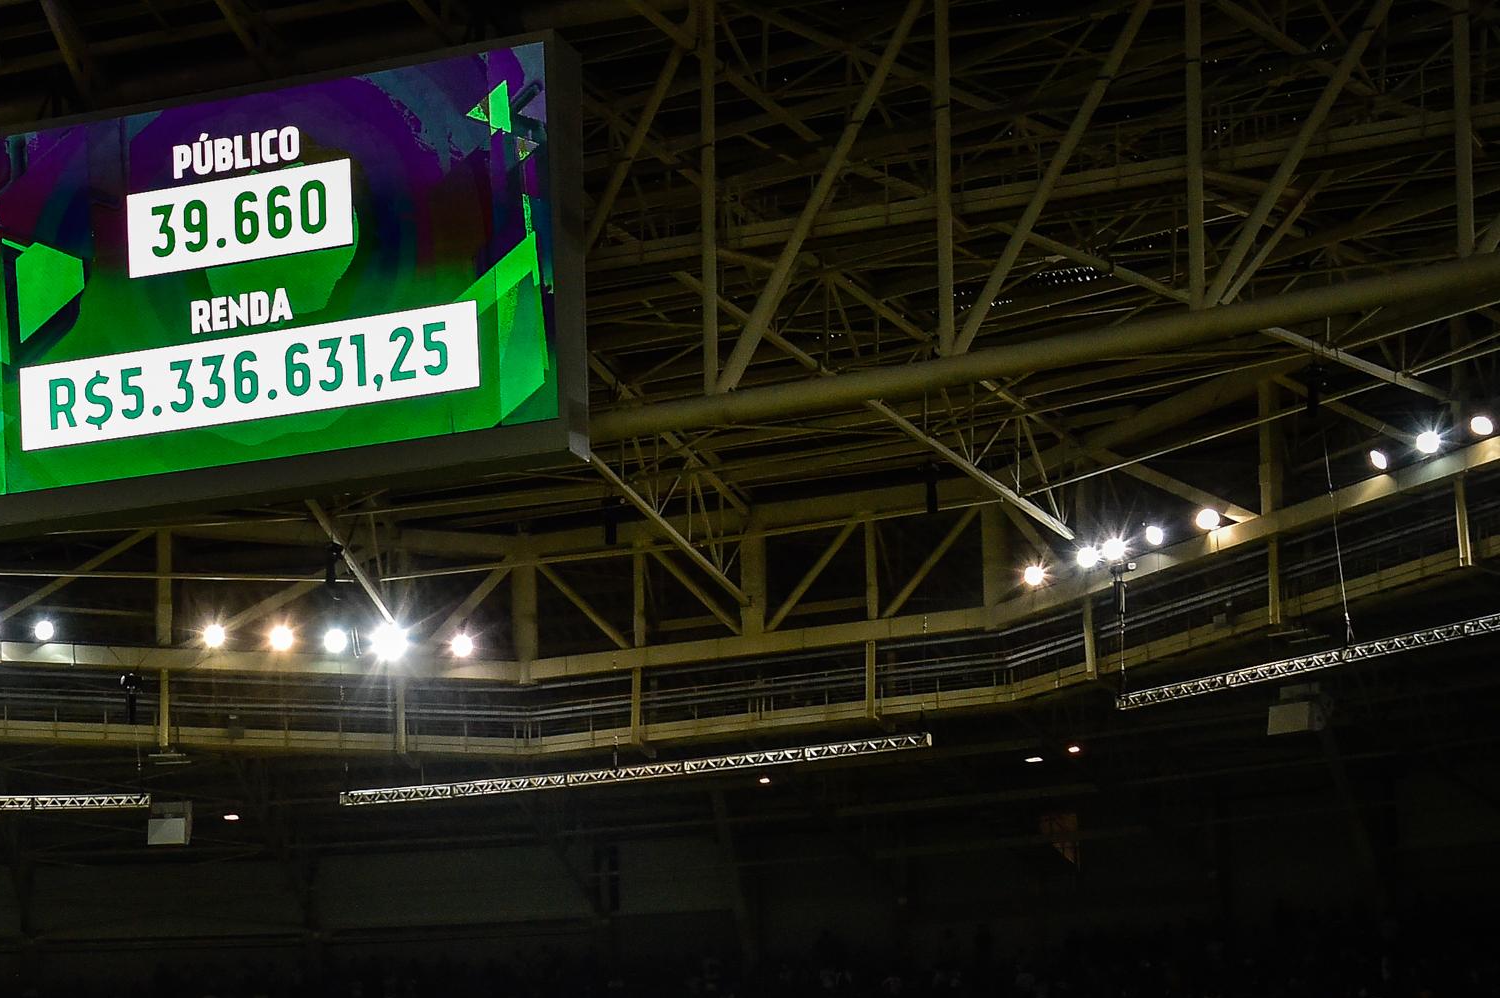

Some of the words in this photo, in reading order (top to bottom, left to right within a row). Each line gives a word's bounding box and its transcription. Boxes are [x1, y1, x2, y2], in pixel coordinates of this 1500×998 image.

[172, 125, 300, 180] PÚBLICO
[150, 179, 328, 257] 39.660
[189, 286, 293, 335] RENDA
[48, 320, 449, 432] R$5.336.631,25
